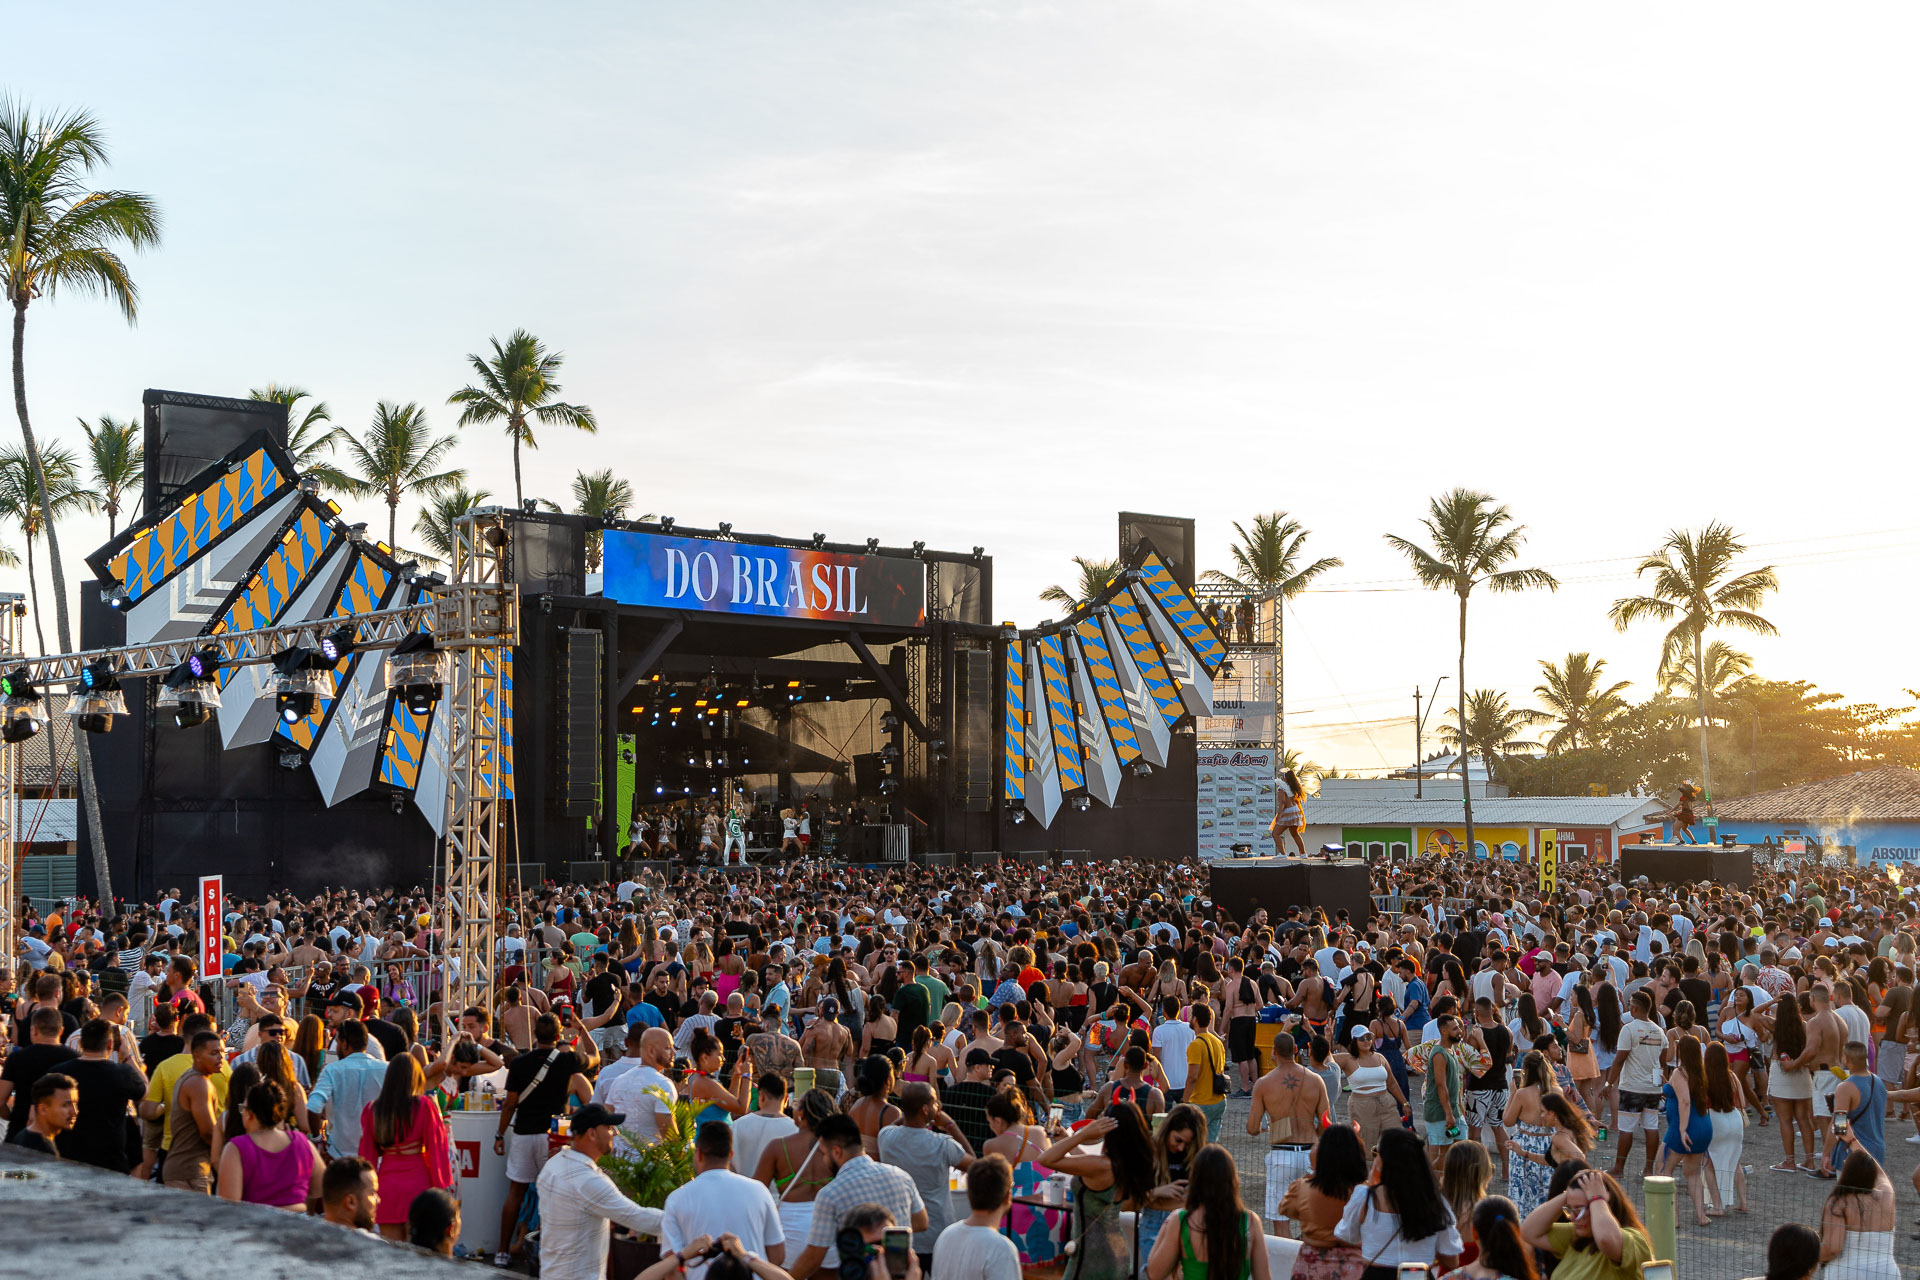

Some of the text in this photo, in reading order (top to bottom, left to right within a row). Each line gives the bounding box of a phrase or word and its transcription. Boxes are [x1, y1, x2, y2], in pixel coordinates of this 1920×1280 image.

[664, 547, 868, 614] DO BRASIL
[1556, 832, 1575, 841] AHMA
[1871, 848, 1920, 860] ABSOLU
[208, 888, 216, 964] SAÍDA
